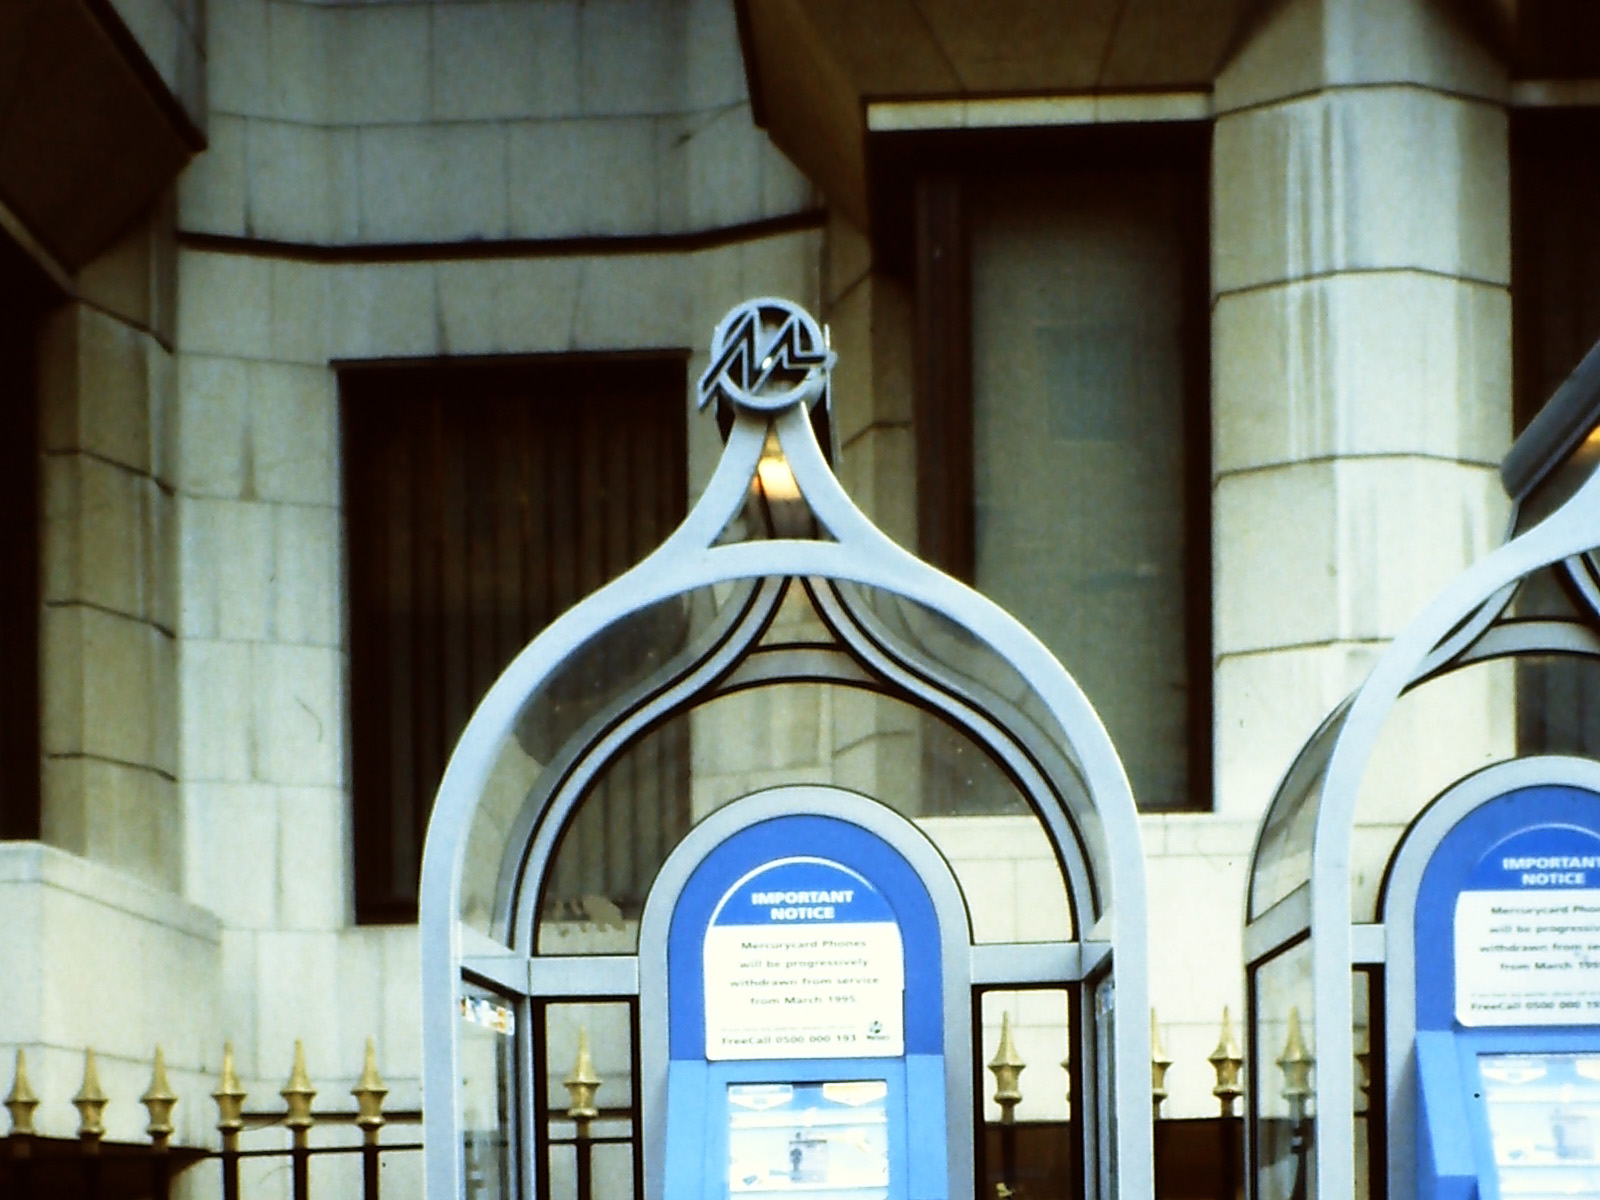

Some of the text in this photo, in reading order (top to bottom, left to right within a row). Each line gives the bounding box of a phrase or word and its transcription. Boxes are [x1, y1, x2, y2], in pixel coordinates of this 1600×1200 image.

[1521, 872, 1586, 885] NOTICE
[751, 890, 854, 904] IMPORTANT
[770, 907, 835, 921] NOTICE
[741, 940, 866, 951] Mercurycard Phones
[740, 957, 868, 969] will be progressively
[730, 976, 879, 988] withdrawn from service
[750, 996, 779, 1005] from
[784, 995, 822, 1005] March
[721, 1036, 771, 1045] FreeCall
